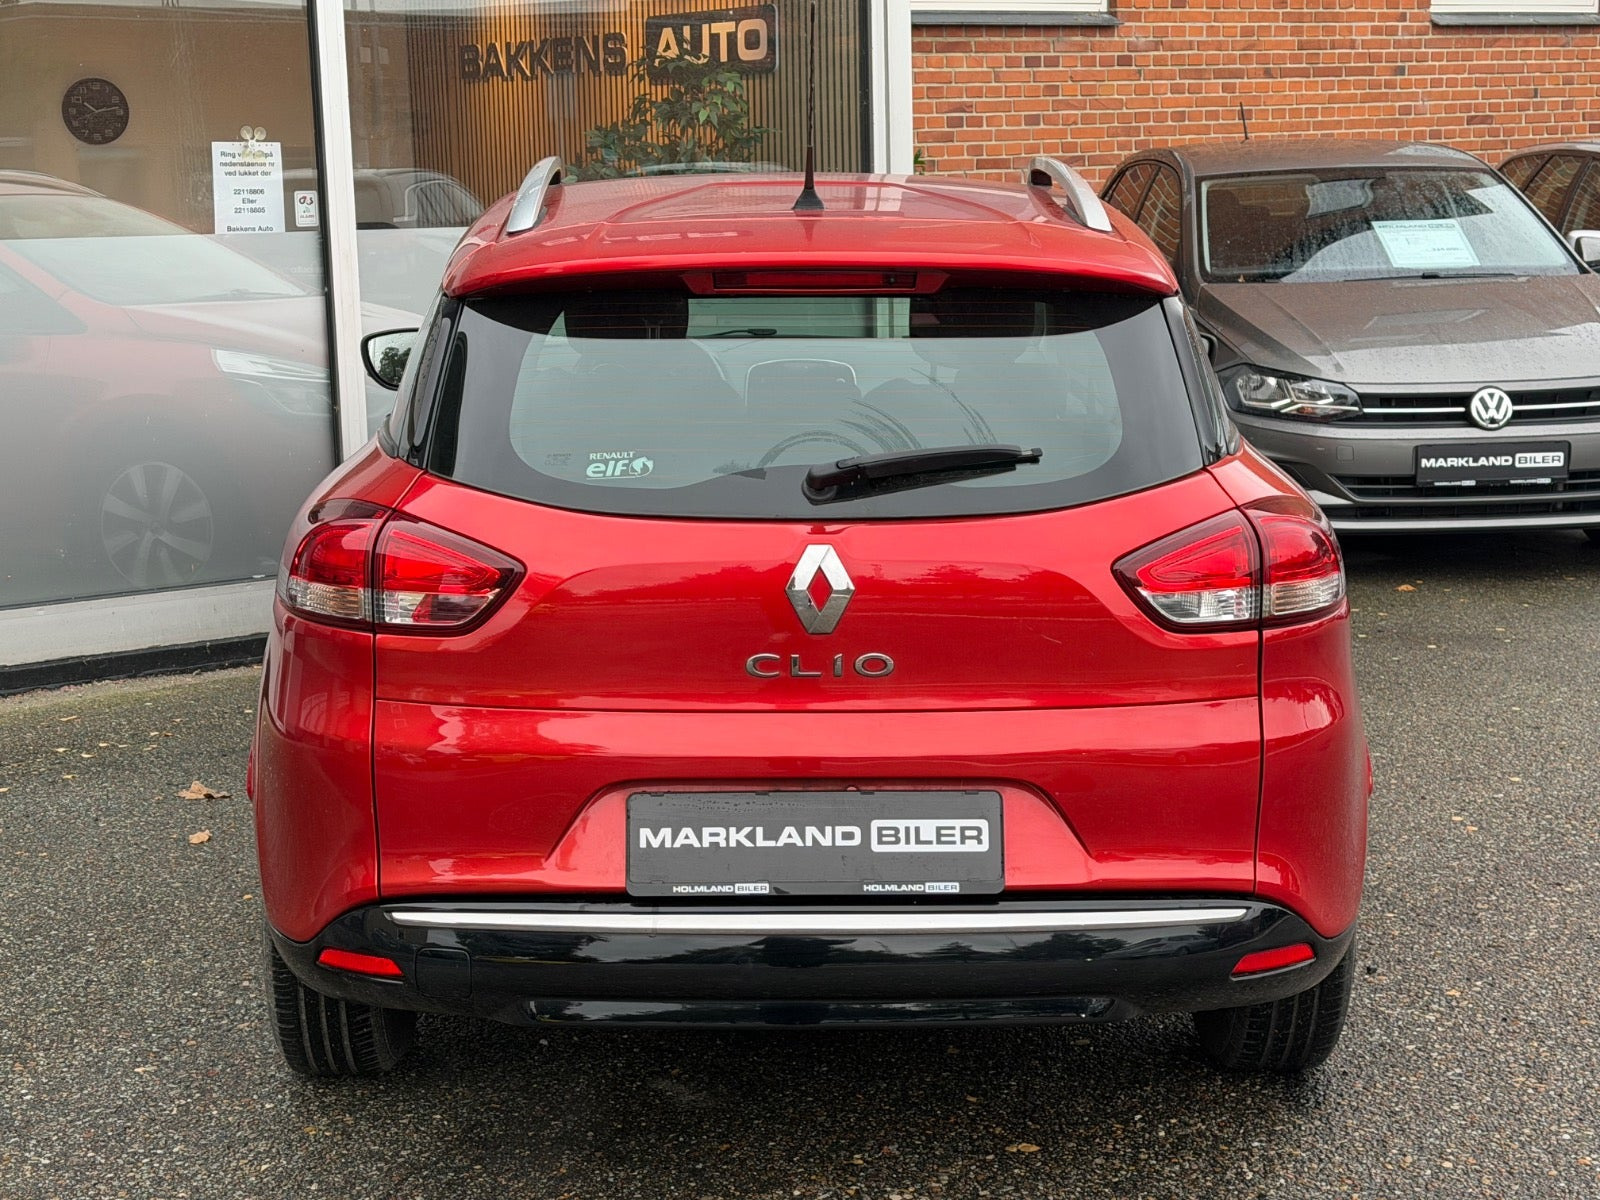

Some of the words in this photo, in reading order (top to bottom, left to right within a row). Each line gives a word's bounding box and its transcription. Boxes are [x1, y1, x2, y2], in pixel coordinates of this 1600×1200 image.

[460, 31, 628, 82] BAKKENS
[656, 18, 768, 66] AUTO
[220, 151, 236, 159] Ring
[265, 150, 273, 159] på
[589, 451, 636, 460] RENAULT
[1421, 456, 1513, 468] MARKLAND
[1517, 455, 1562, 465] BILER
[586, 460, 629, 478] elf
[745, 653, 895, 678] CLIO
[639, 825, 862, 848] MARKLAND
[876, 825, 984, 846] BILER
[673, 885, 734, 894] HOLMLAND
[737, 885, 768, 894] BILER
[863, 884, 925, 892] HOLMLAND
[927, 884, 958, 892] BILER
